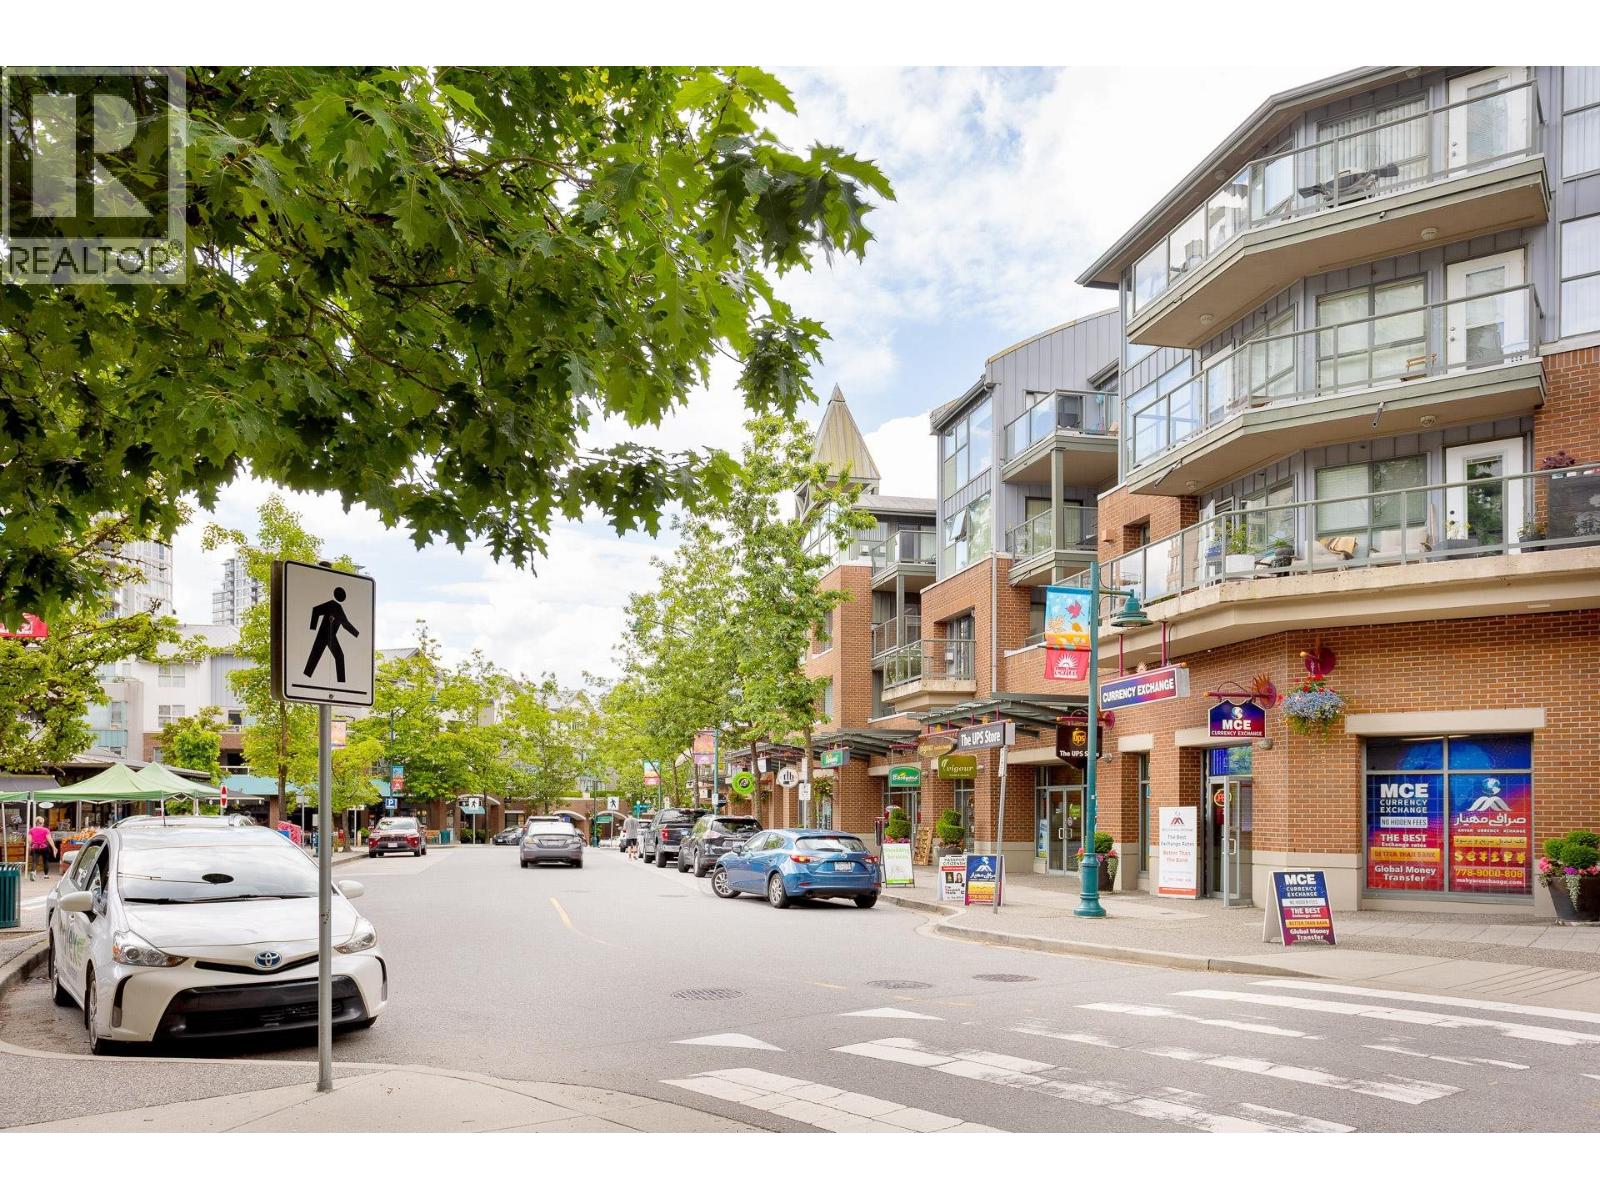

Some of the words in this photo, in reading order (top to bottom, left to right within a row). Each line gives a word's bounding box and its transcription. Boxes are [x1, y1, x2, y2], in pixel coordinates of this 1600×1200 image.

[1103, 686, 1137, 702] CURRENCY
[1137, 678, 1174, 695] EXCHANGE
[1222, 719, 1252, 730] MCE
[961, 733, 972, 747] The
[972, 731, 984, 745] UPS
[984, 729, 1001, 744] Store
[1380, 783, 1429, 798] MCE
[1380, 806, 1428, 814] EXCHANGE
[1381, 818, 1390, 826] NO
[1391, 818, 1412, 826] HIDDEN
[1412, 818, 1427, 826] FEES
[1380, 833, 1400, 842] THE
[1402, 834, 1428, 843] BEST
[1374, 865, 1403, 873] Global
[1405, 866, 1437, 876] Money
[1284, 873, 1317, 885] MCE
[1383, 873, 1426, 882] Transfer
[1310, 928, 1330, 936] Money
